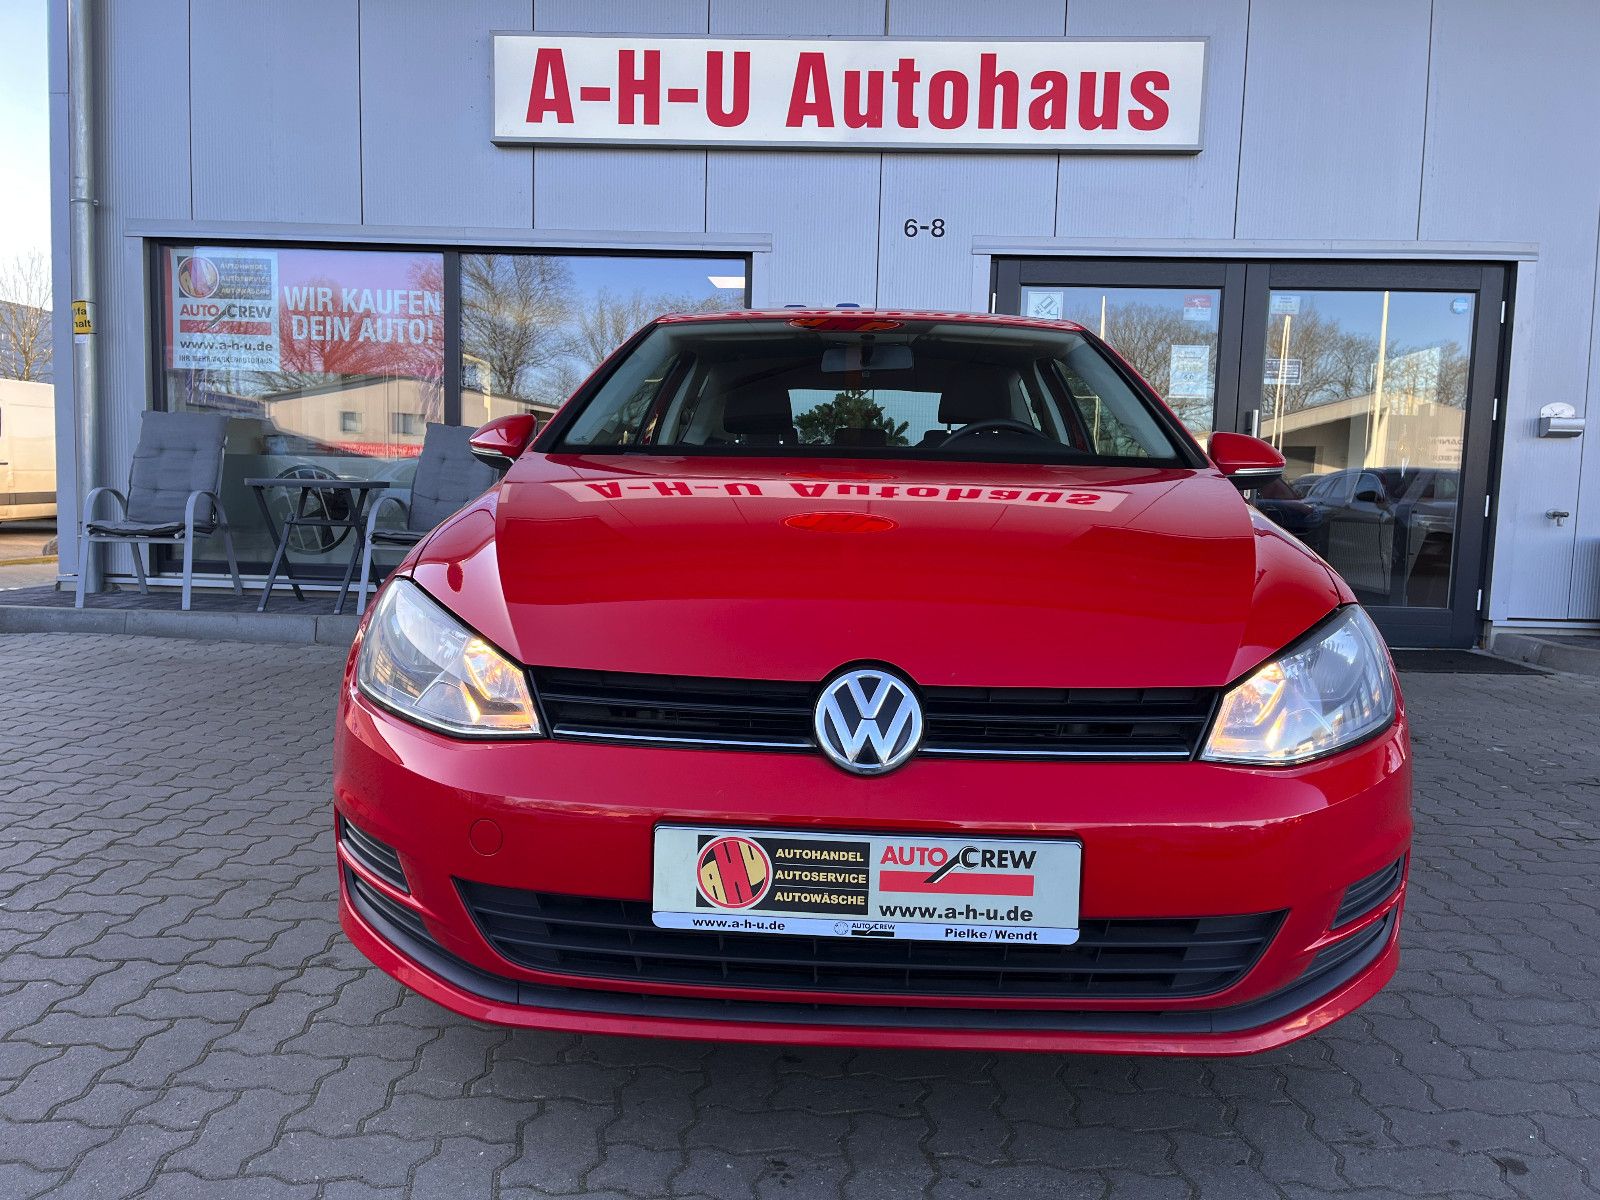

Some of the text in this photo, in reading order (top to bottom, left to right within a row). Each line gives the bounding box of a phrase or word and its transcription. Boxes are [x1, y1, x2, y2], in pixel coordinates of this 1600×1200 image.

[527, 49, 1169, 131] A-H-U Autohaus
[904, 218, 945, 238] 6-8
[284, 286, 441, 316] WIR KAUFEN
[180, 304, 272, 319] AUTO CREW
[292, 314, 433, 345] DEIN AUTO!
[180, 341, 273, 352] www.a-h-u.de
[775, 848, 864, 862] AUTOHANDEL
[880, 845, 1037, 870] AUTO CREW
[774, 870, 867, 884] AUTOSERVICE
[774, 891, 866, 906] AUTOWÄSCHE
[879, 904, 1034, 922] www.a-h-u.de
[692, 918, 785, 931] www.a-h-u.de
